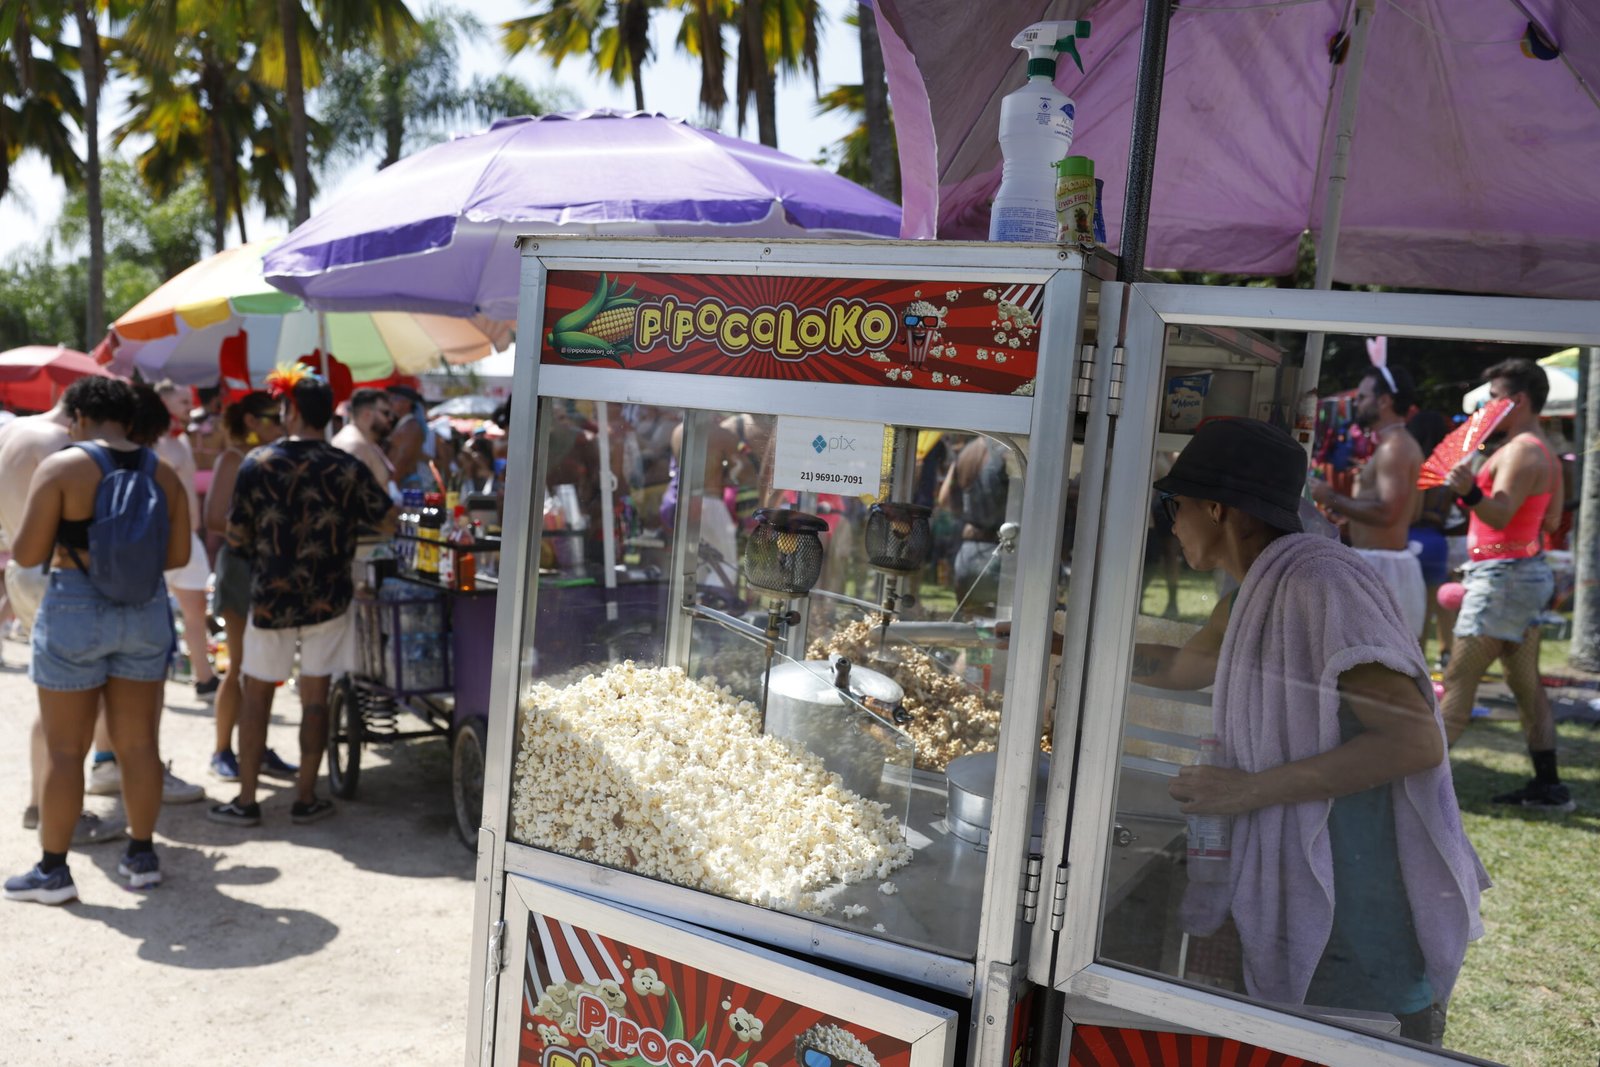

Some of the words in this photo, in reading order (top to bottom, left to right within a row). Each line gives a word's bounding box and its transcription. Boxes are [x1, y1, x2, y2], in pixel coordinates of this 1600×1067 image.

[638, 300, 893, 356] PIPOCOLOKO
[828, 435, 856, 452] pix
[800, 472, 814, 482] 21)
[815, 472, 863, 484] 96910-7091
[578, 994, 738, 1067] PIPOC
